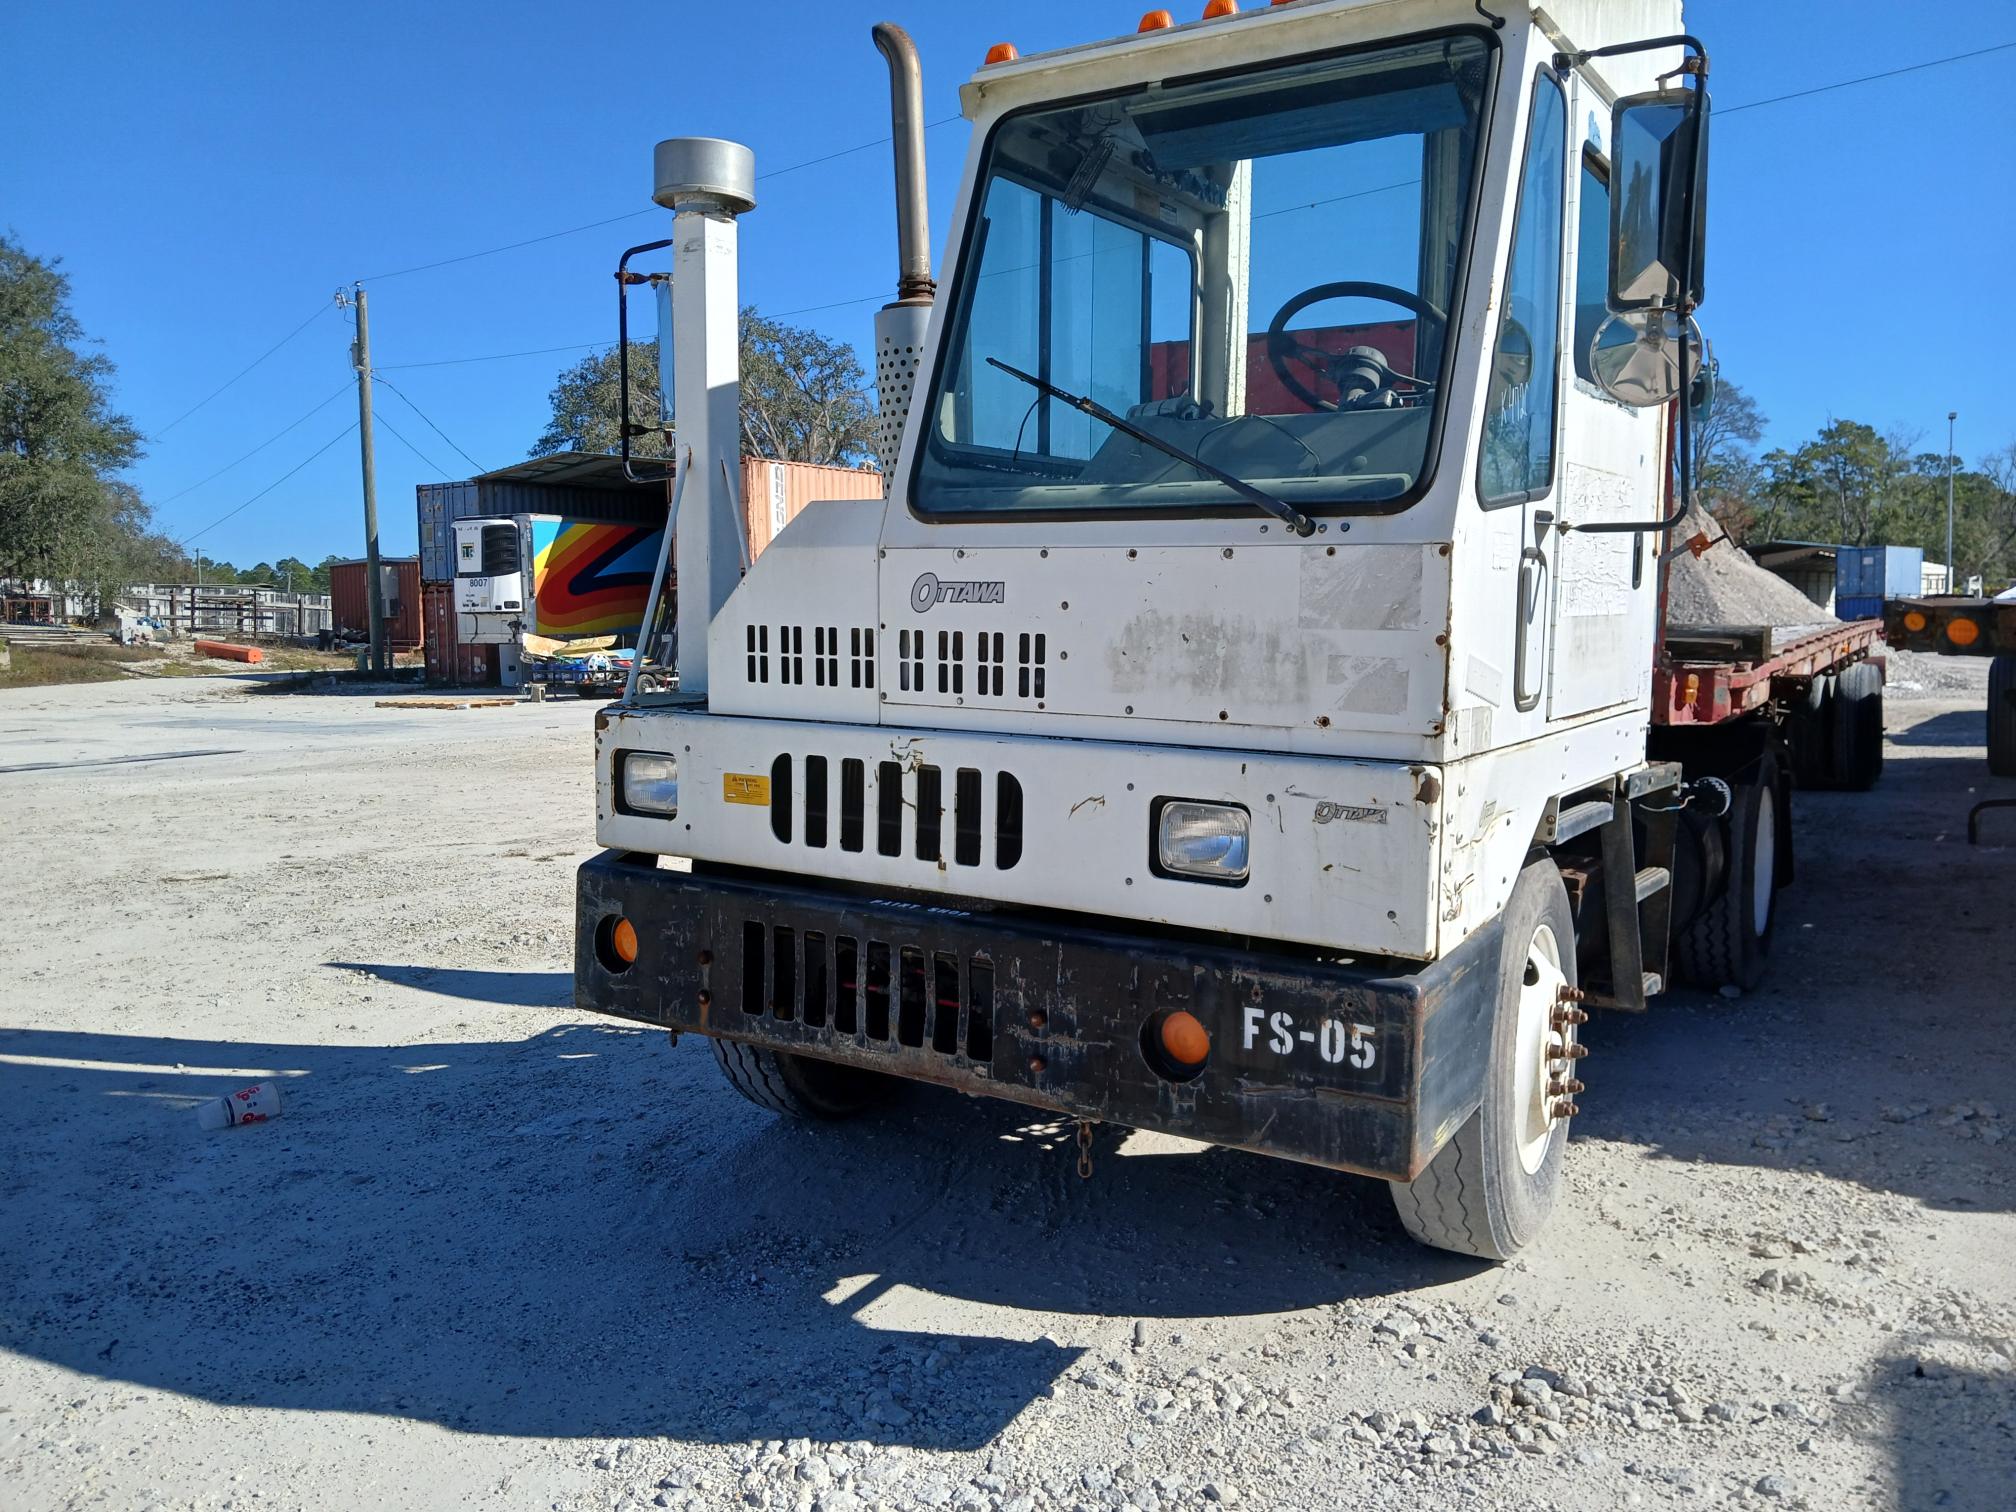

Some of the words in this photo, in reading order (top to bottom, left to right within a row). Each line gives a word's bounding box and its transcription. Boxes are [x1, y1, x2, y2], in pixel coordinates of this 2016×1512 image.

[469, 579, 488, 588] 8007
[911, 572, 1005, 613] OTTAWA
[927, 907, 971, 917] SHOP
[1243, 1006, 1377, 1070] FS-05
